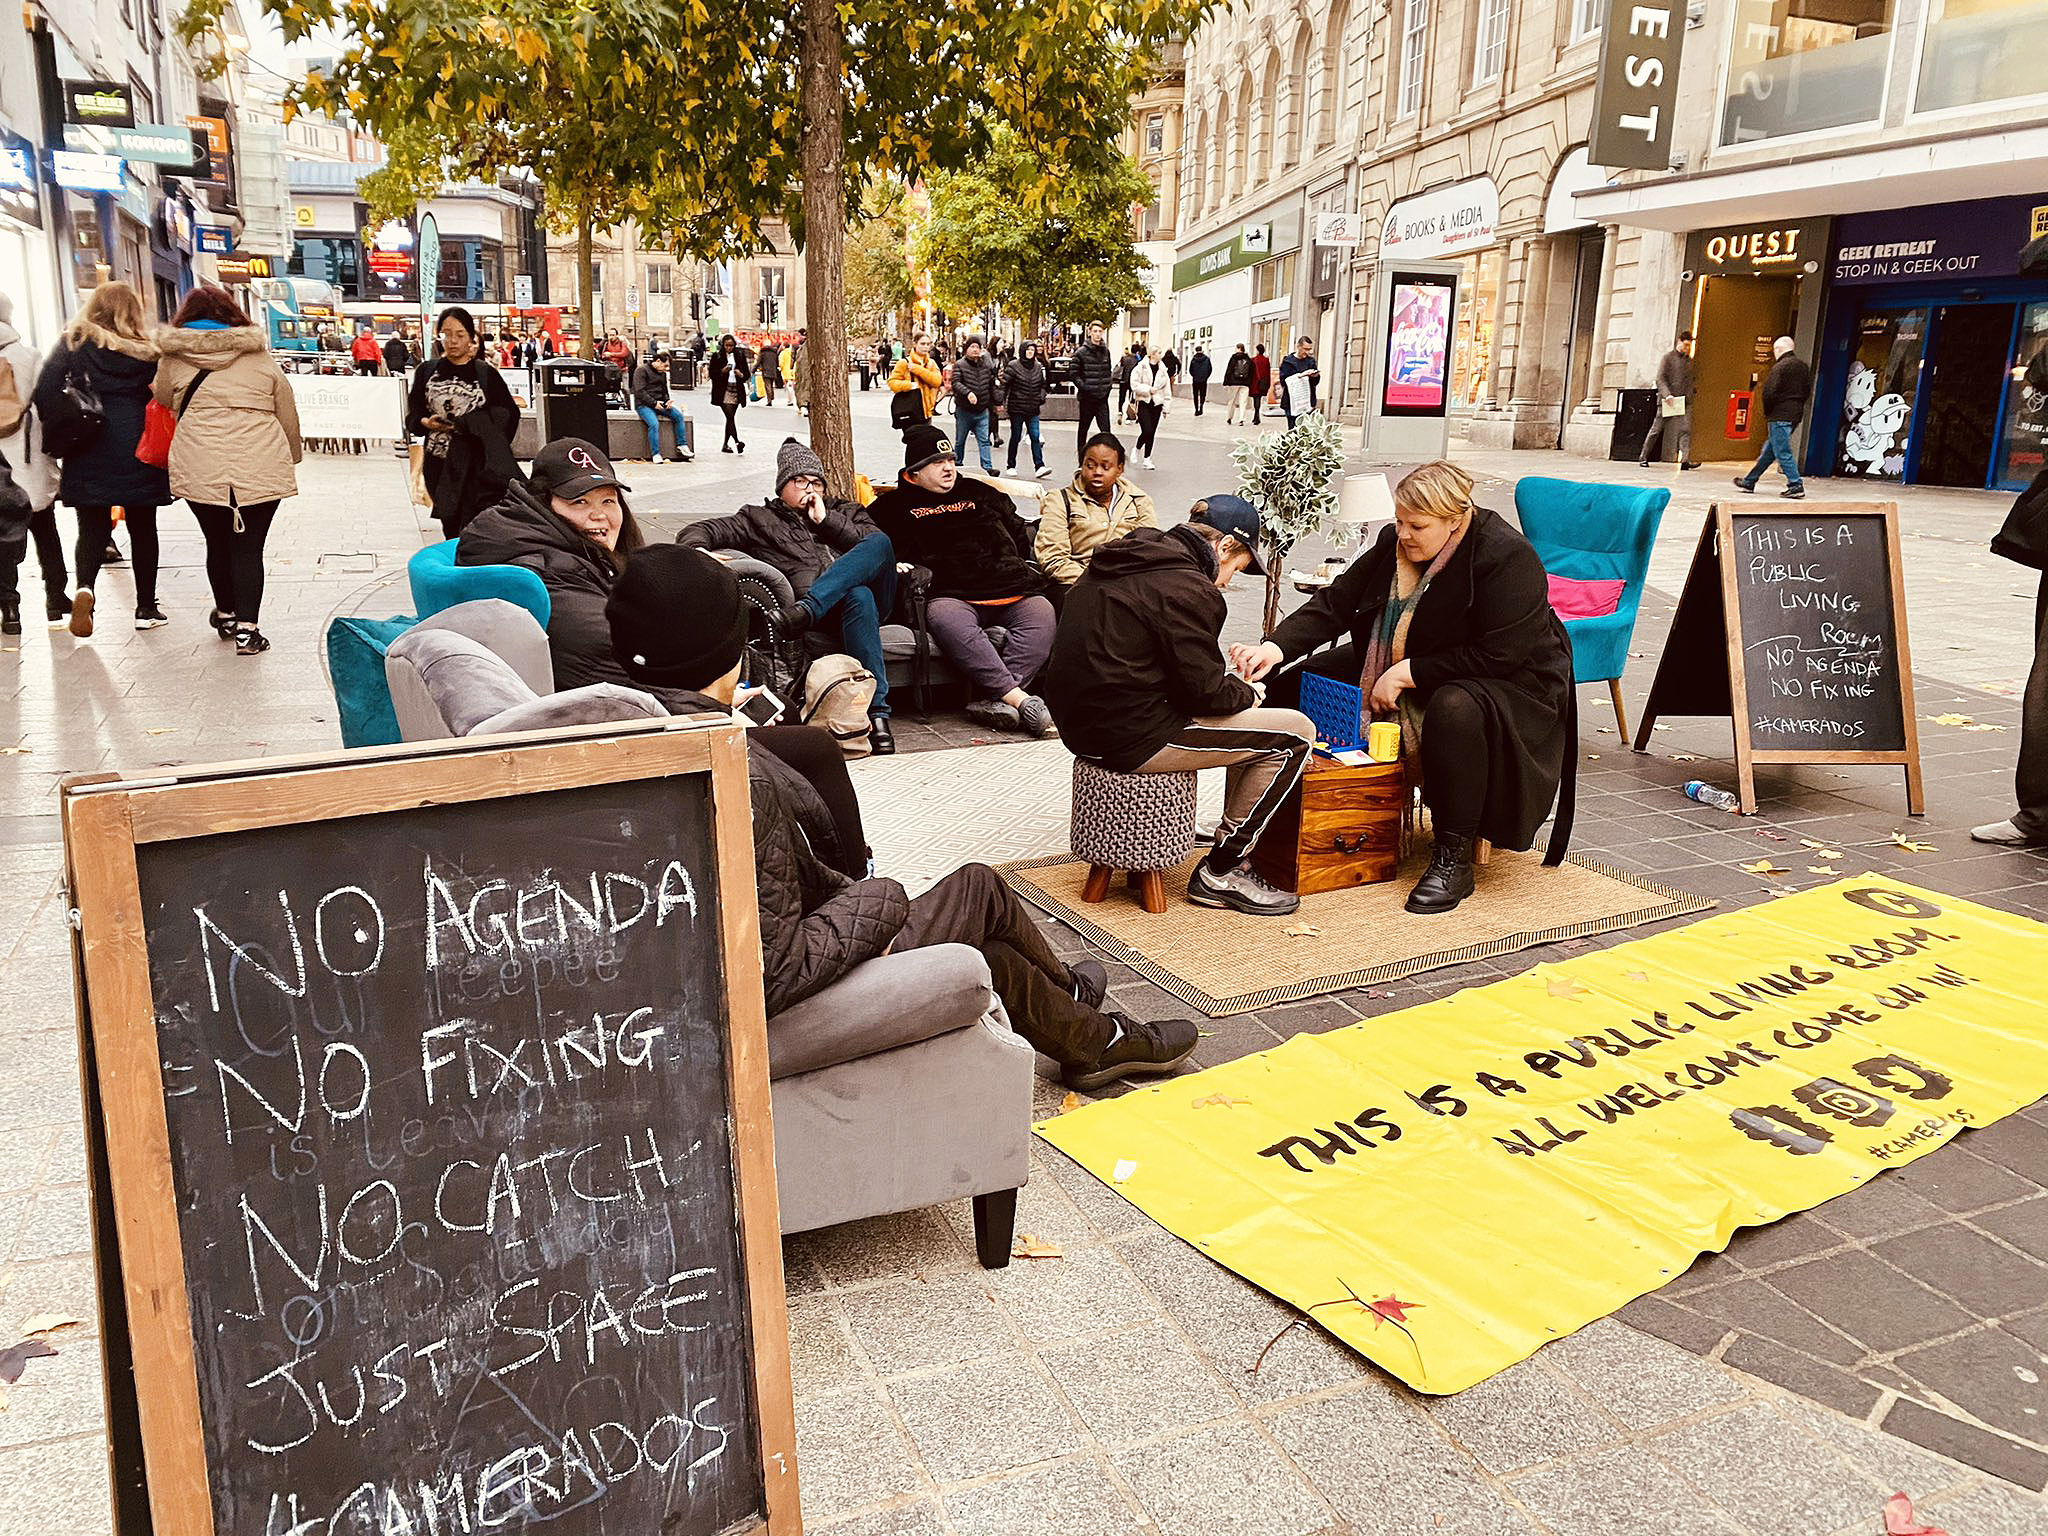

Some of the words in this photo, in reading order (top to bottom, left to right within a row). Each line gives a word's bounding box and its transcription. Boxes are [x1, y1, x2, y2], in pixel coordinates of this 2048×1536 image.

[121, 134, 188, 154] KOKORO
[1405, 217, 1435, 241] BOOKS
[1439, 215, 1446, 231] &
[1451, 205, 1483, 230] MEDIA
[1706, 229, 1801, 264] QUEST
[1839, 245, 1874, 261] GEEK
[1874, 240, 1937, 258] RETREAT
[1835, 264, 1871, 278] STOP
[1873, 262, 1888, 276] IN
[1890, 261, 1900, 275] &
[1903, 258, 1944, 274] GEEK
[1946, 255, 1980, 271] OUT
[1740, 524, 1797, 550] THIS
[1805, 527, 1826, 545] IS
[1836, 524, 1854, 546] A
[1749, 556, 1827, 584] PUBLIC
[1780, 588, 1861, 612] LIVING
[1821, 622, 1883, 651] ROOM
[1766, 644, 1794, 670] NO
[1806, 657, 1882, 678] AGENDA
[1771, 677, 1803, 698] NO
[1810, 679, 1875, 700] FIXING
[1754, 715, 1866, 738] #CAMERADOS
[192, 885, 385, 1012] NO
[424, 858, 698, 972] AGENDA
[1257, 1107, 1402, 1173] THIS
[1404, 1084, 1468, 1117] IS
[1476, 1071, 1527, 1098] A
[1524, 1010, 1695, 1079] PUBLIC
[1685, 965, 1834, 1021] LIVING
[1825, 927, 1961, 969] ROOM.
[214, 1034, 371, 1145] NO
[421, 1006, 666, 1106] FIXING
[1492, 1117, 1588, 1157] ALL
[1577, 1041, 1780, 1124] WELCOME
[1774, 1003, 1882, 1049] COME
[1873, 983, 1931, 1010] ON
[226, 1179, 405, 1320] NO
[245, 1337, 448, 1455] JUST
[489, 1266, 719, 1380] SPACE
